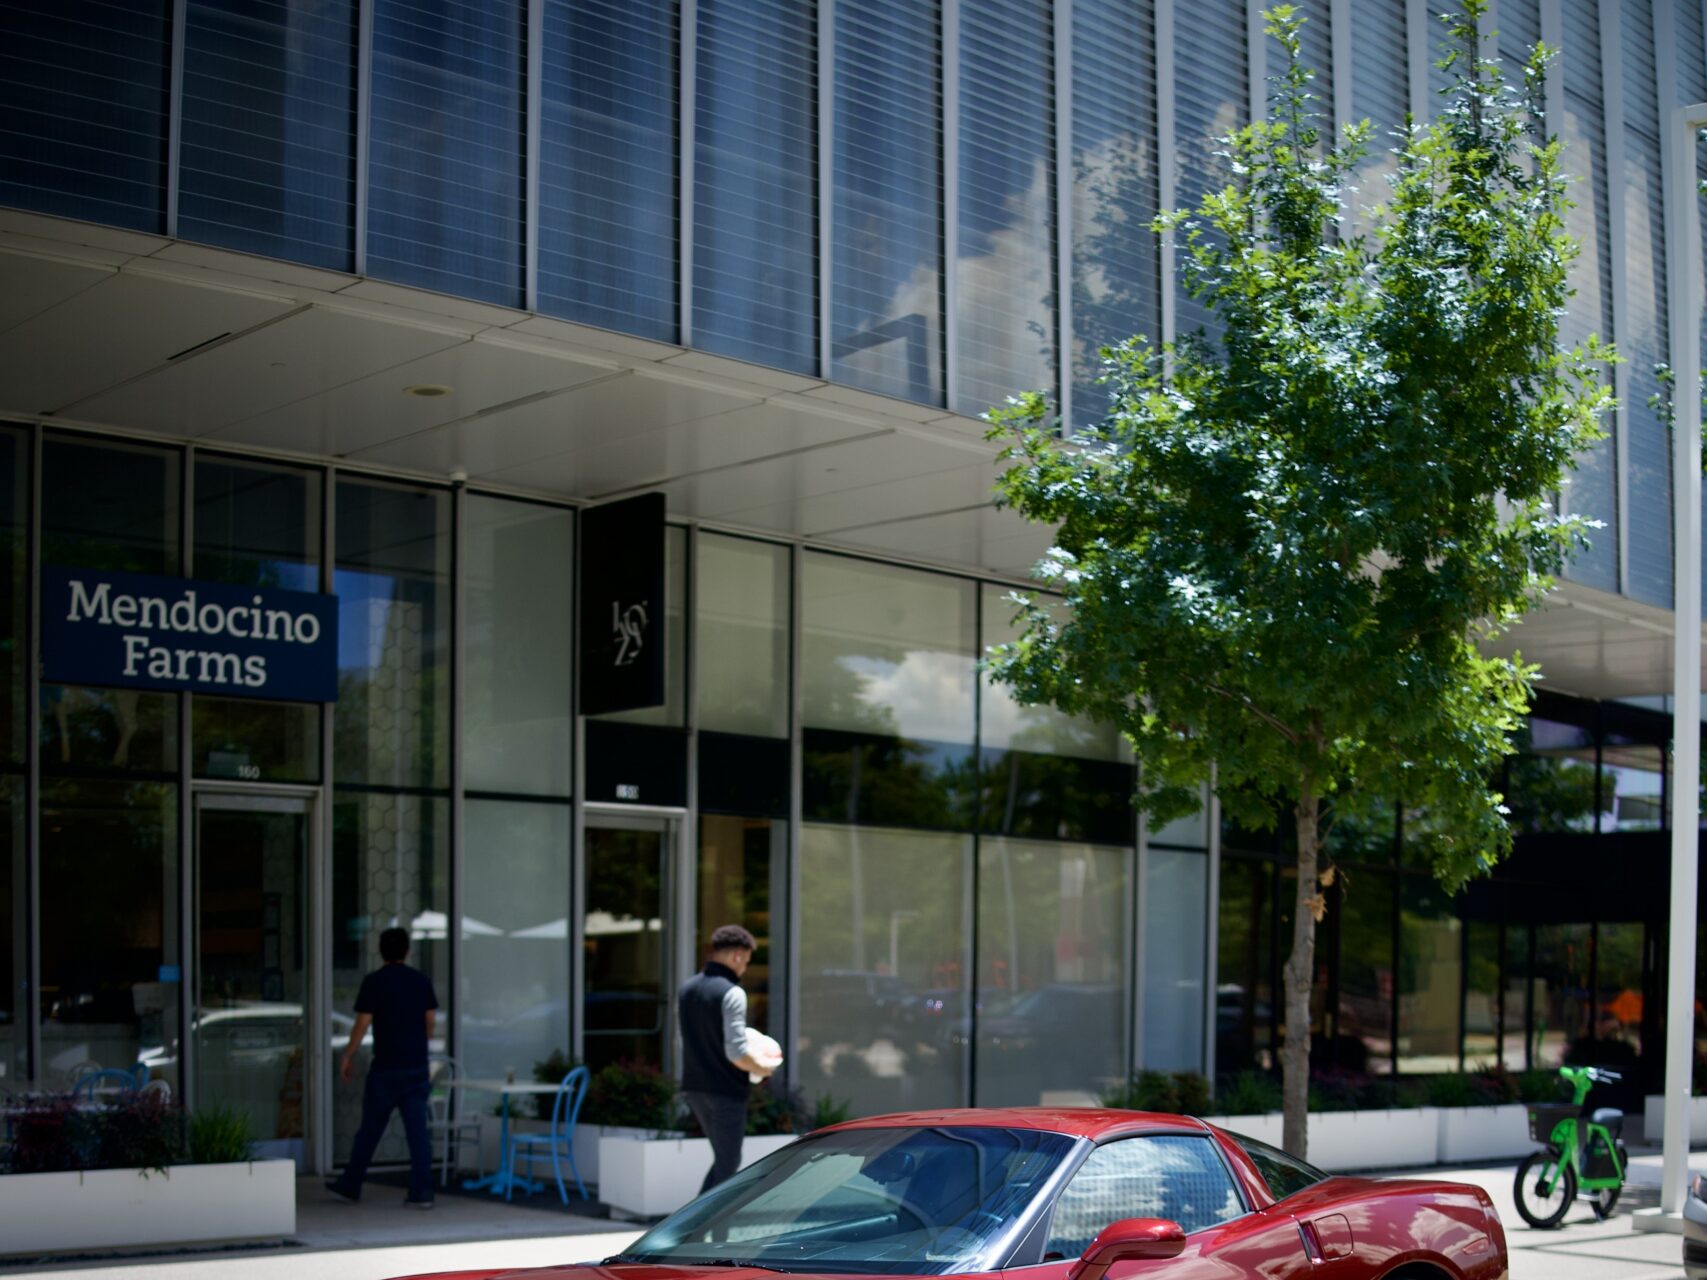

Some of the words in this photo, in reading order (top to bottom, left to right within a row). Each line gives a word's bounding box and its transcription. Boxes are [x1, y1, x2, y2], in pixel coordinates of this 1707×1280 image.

[66, 580, 321, 644] Mendocino
[122, 635, 267, 688] Farms
[238, 765, 260, 779] 160
